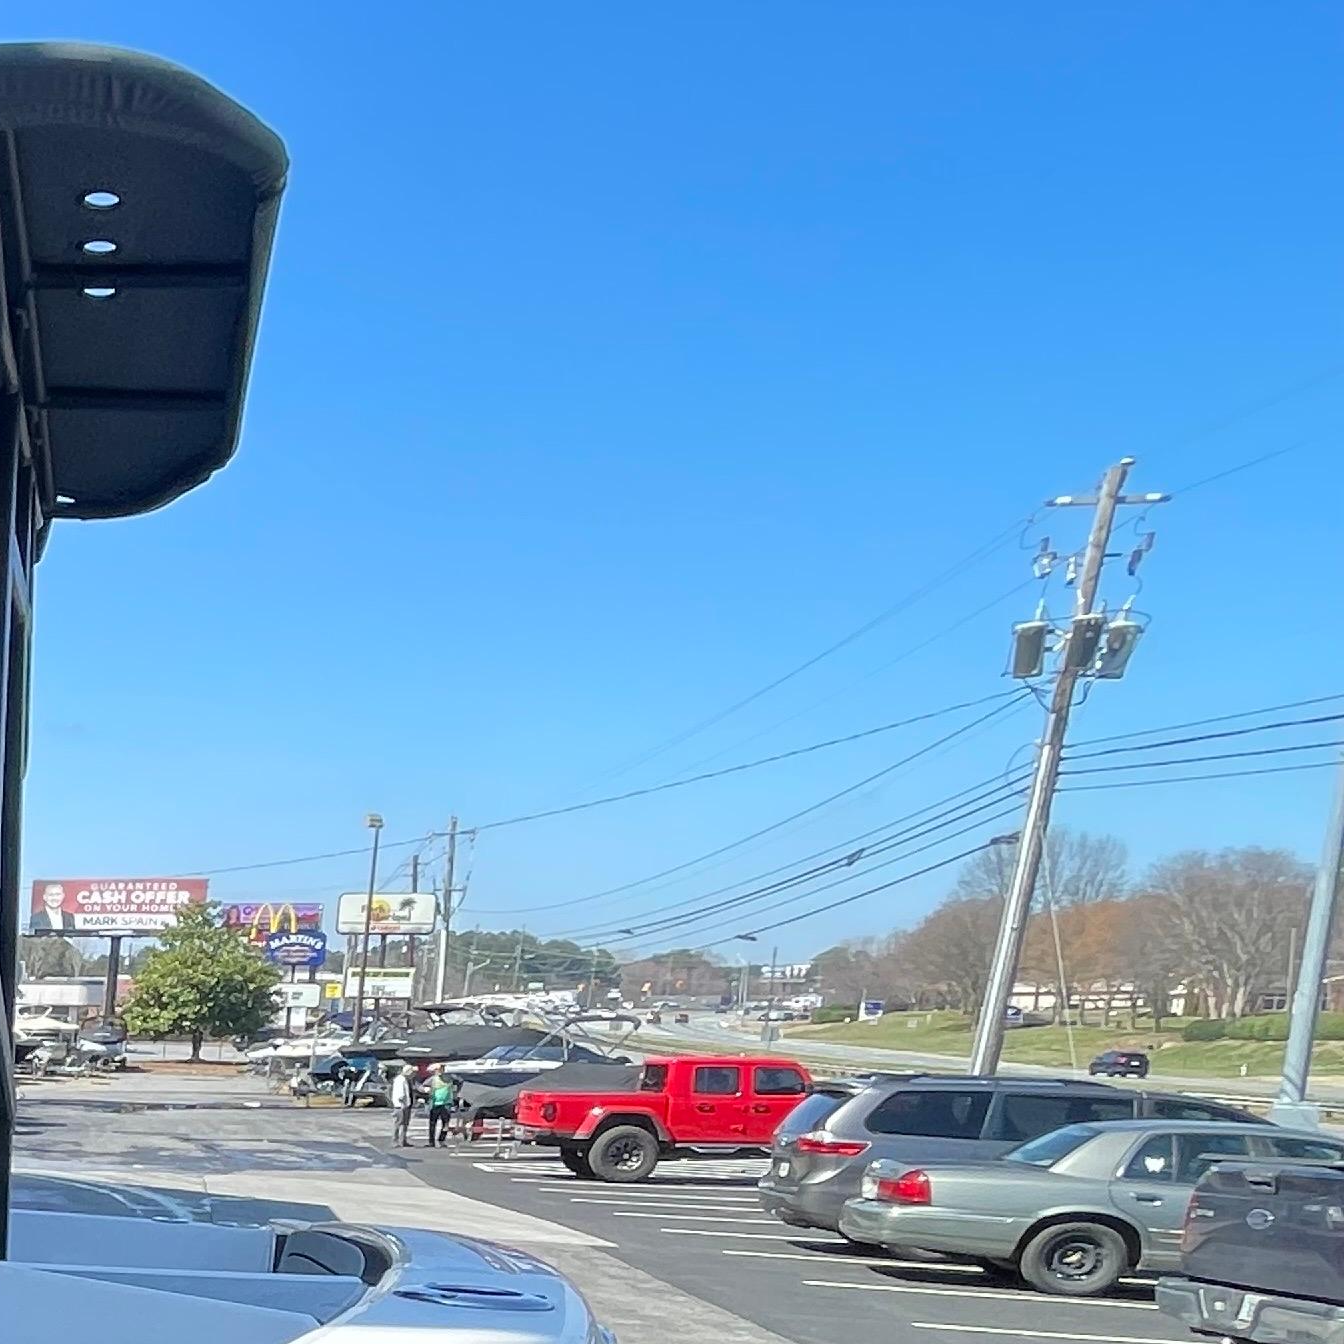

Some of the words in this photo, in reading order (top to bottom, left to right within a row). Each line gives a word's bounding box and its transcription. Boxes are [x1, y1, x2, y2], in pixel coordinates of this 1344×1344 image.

[90, 882, 178, 891] GUARANTEED
[76, 890, 127, 904] CASH
[130, 890, 191, 904] OFFER
[84, 904, 101, 912] ON
[106, 904, 138, 912] YOUR
[82, 916, 118, 926] MARK
[121, 916, 158, 926] SPAIN
